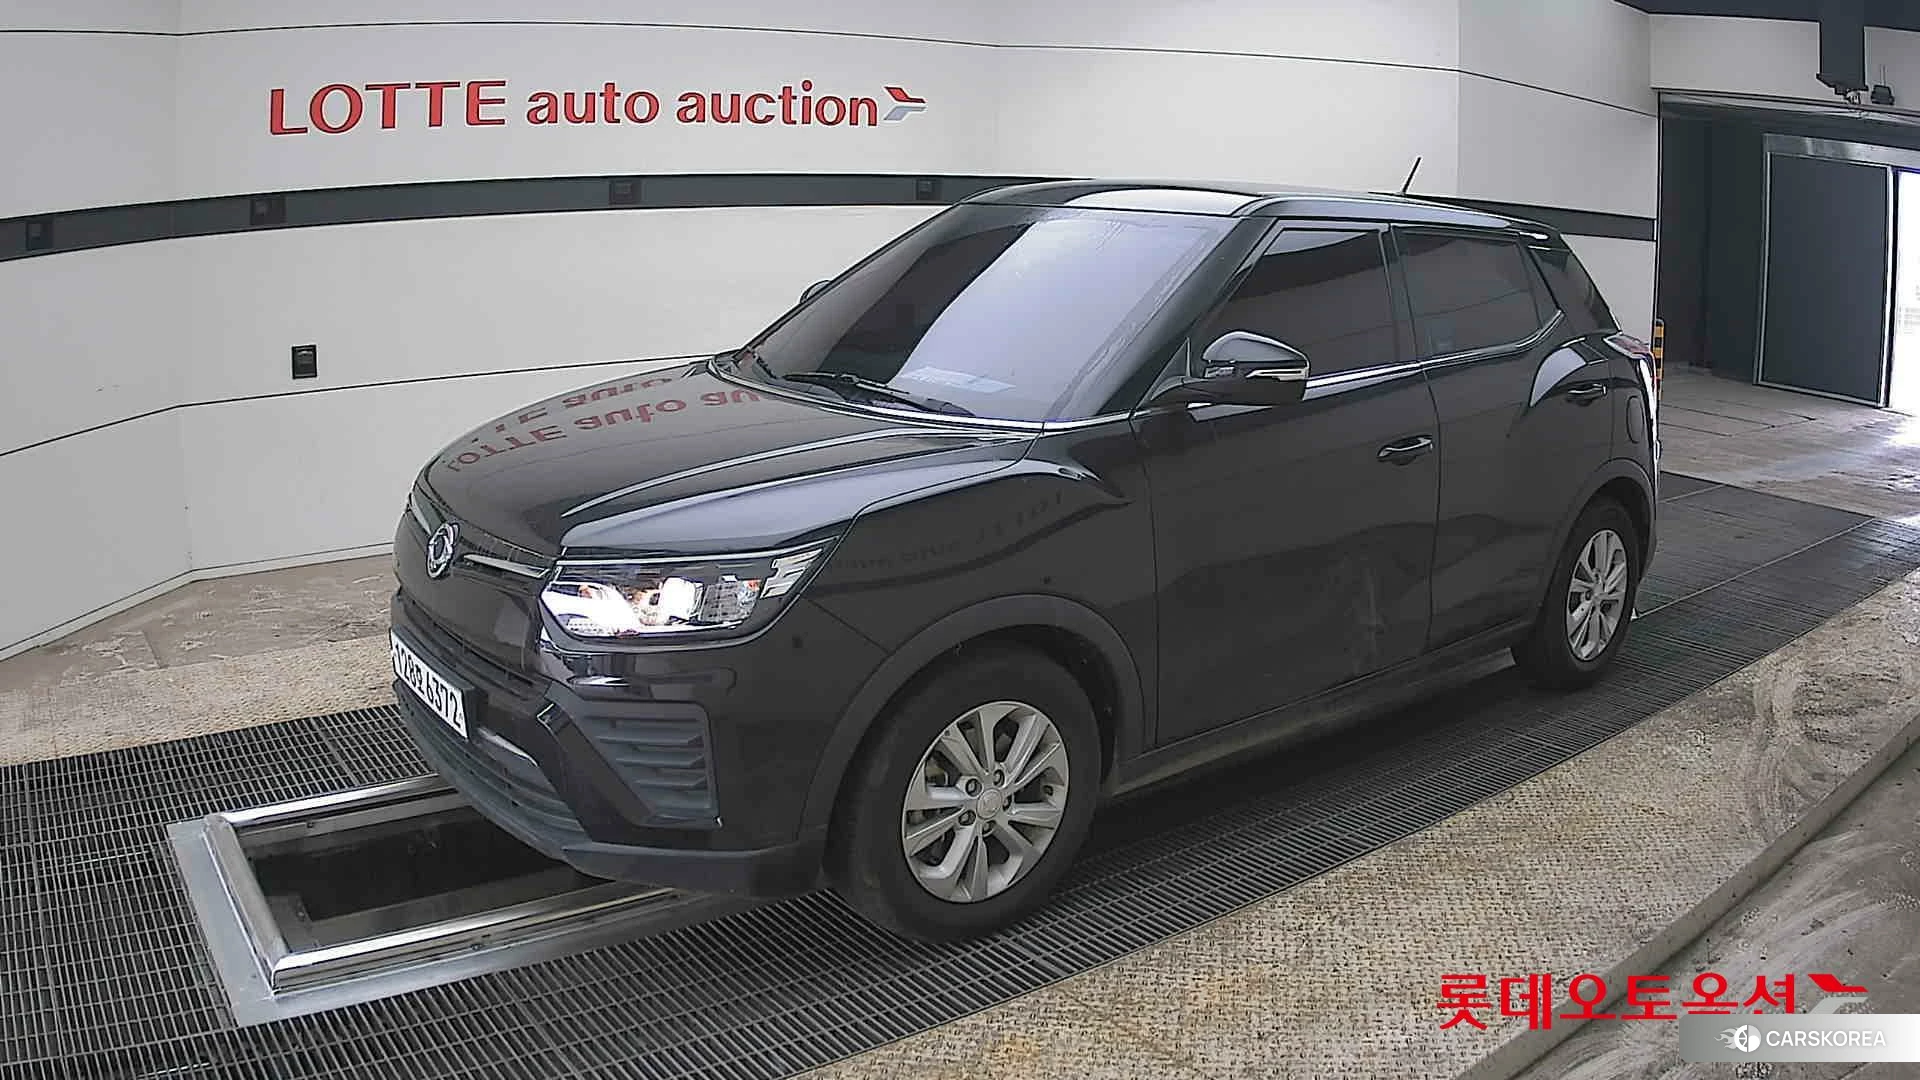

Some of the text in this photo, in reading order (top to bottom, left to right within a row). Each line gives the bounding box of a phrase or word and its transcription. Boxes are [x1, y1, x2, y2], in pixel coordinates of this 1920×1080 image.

[270, 79, 878, 136] LOTTE auto auction
[426, 671, 462, 728] 6372
